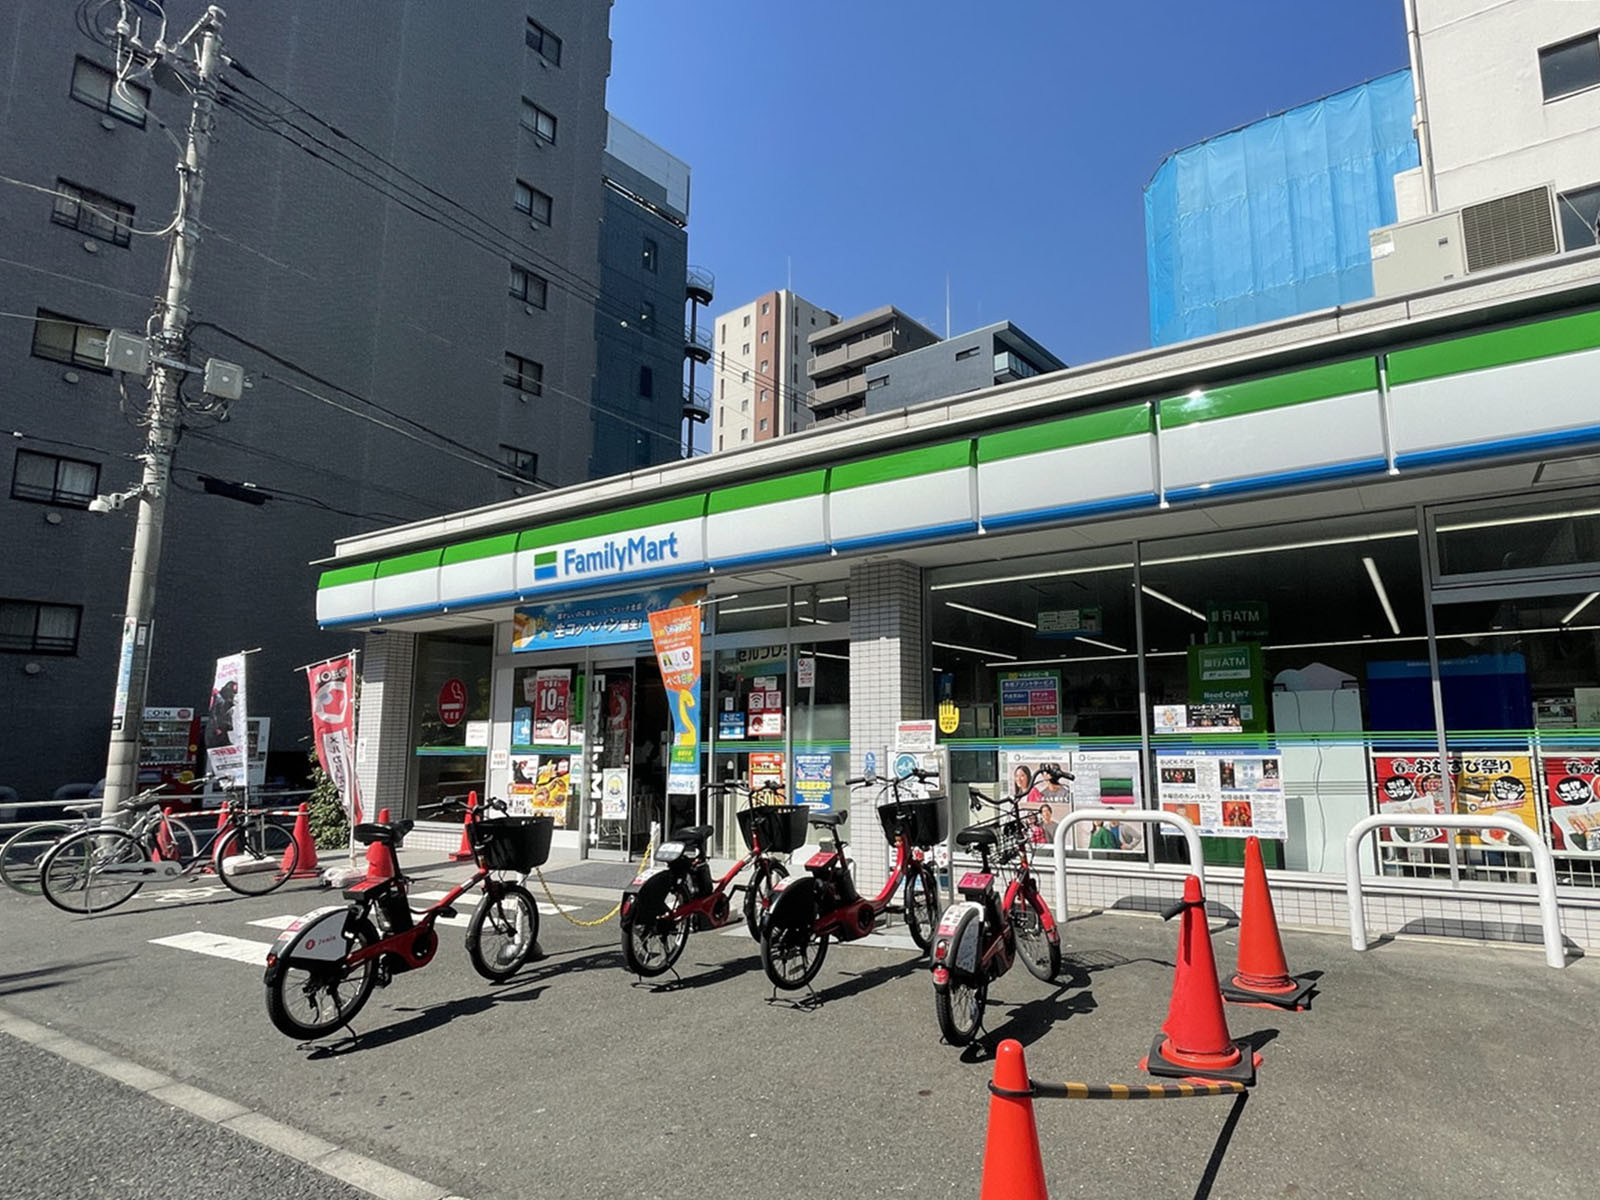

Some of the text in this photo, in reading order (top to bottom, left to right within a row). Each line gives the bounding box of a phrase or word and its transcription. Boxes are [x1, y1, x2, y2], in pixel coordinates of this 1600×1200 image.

[564, 531, 678, 576] FamilyMart
[1203, 690, 1249, 699] Need Cash?
